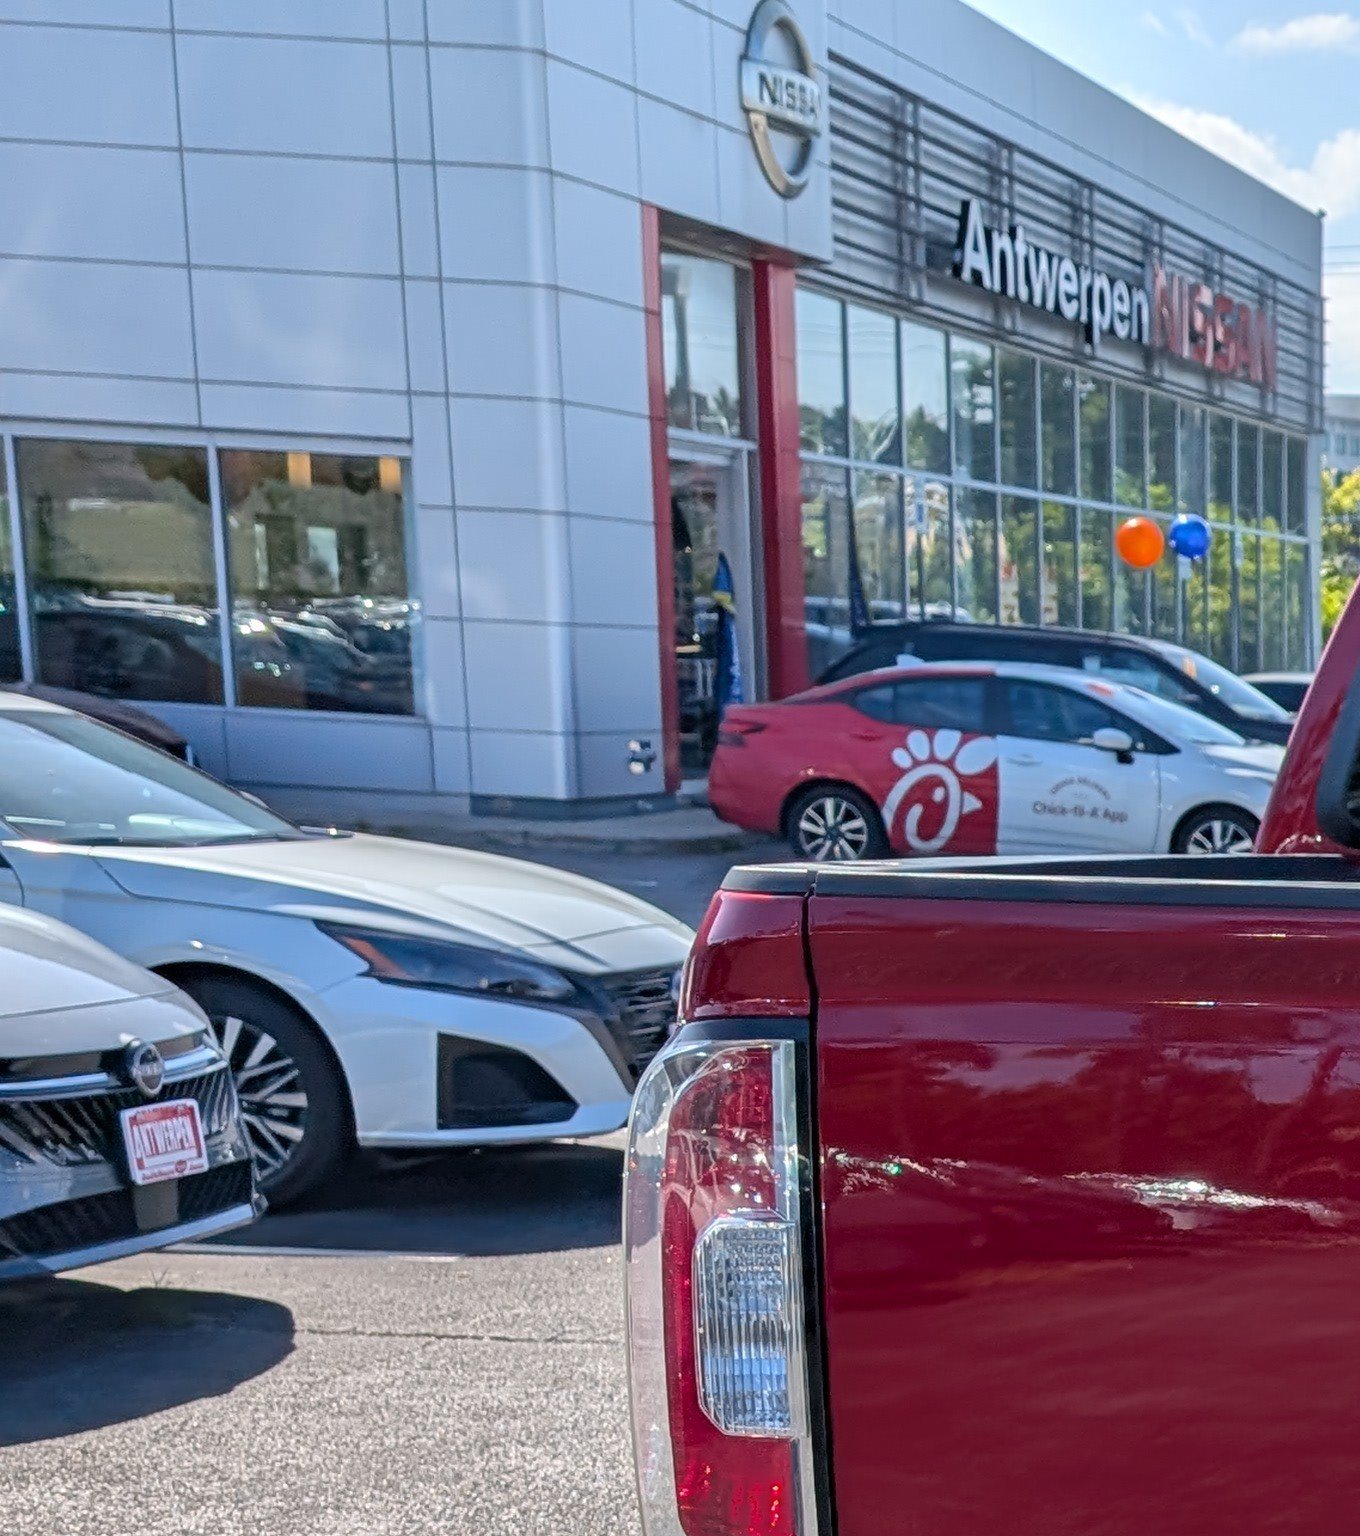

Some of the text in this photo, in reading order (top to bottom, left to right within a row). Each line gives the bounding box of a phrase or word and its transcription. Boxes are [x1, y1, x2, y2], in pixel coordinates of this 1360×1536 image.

[758, 72, 820, 118] NISSA
[961, 199, 1277, 391] Antwerpen NISSAN
